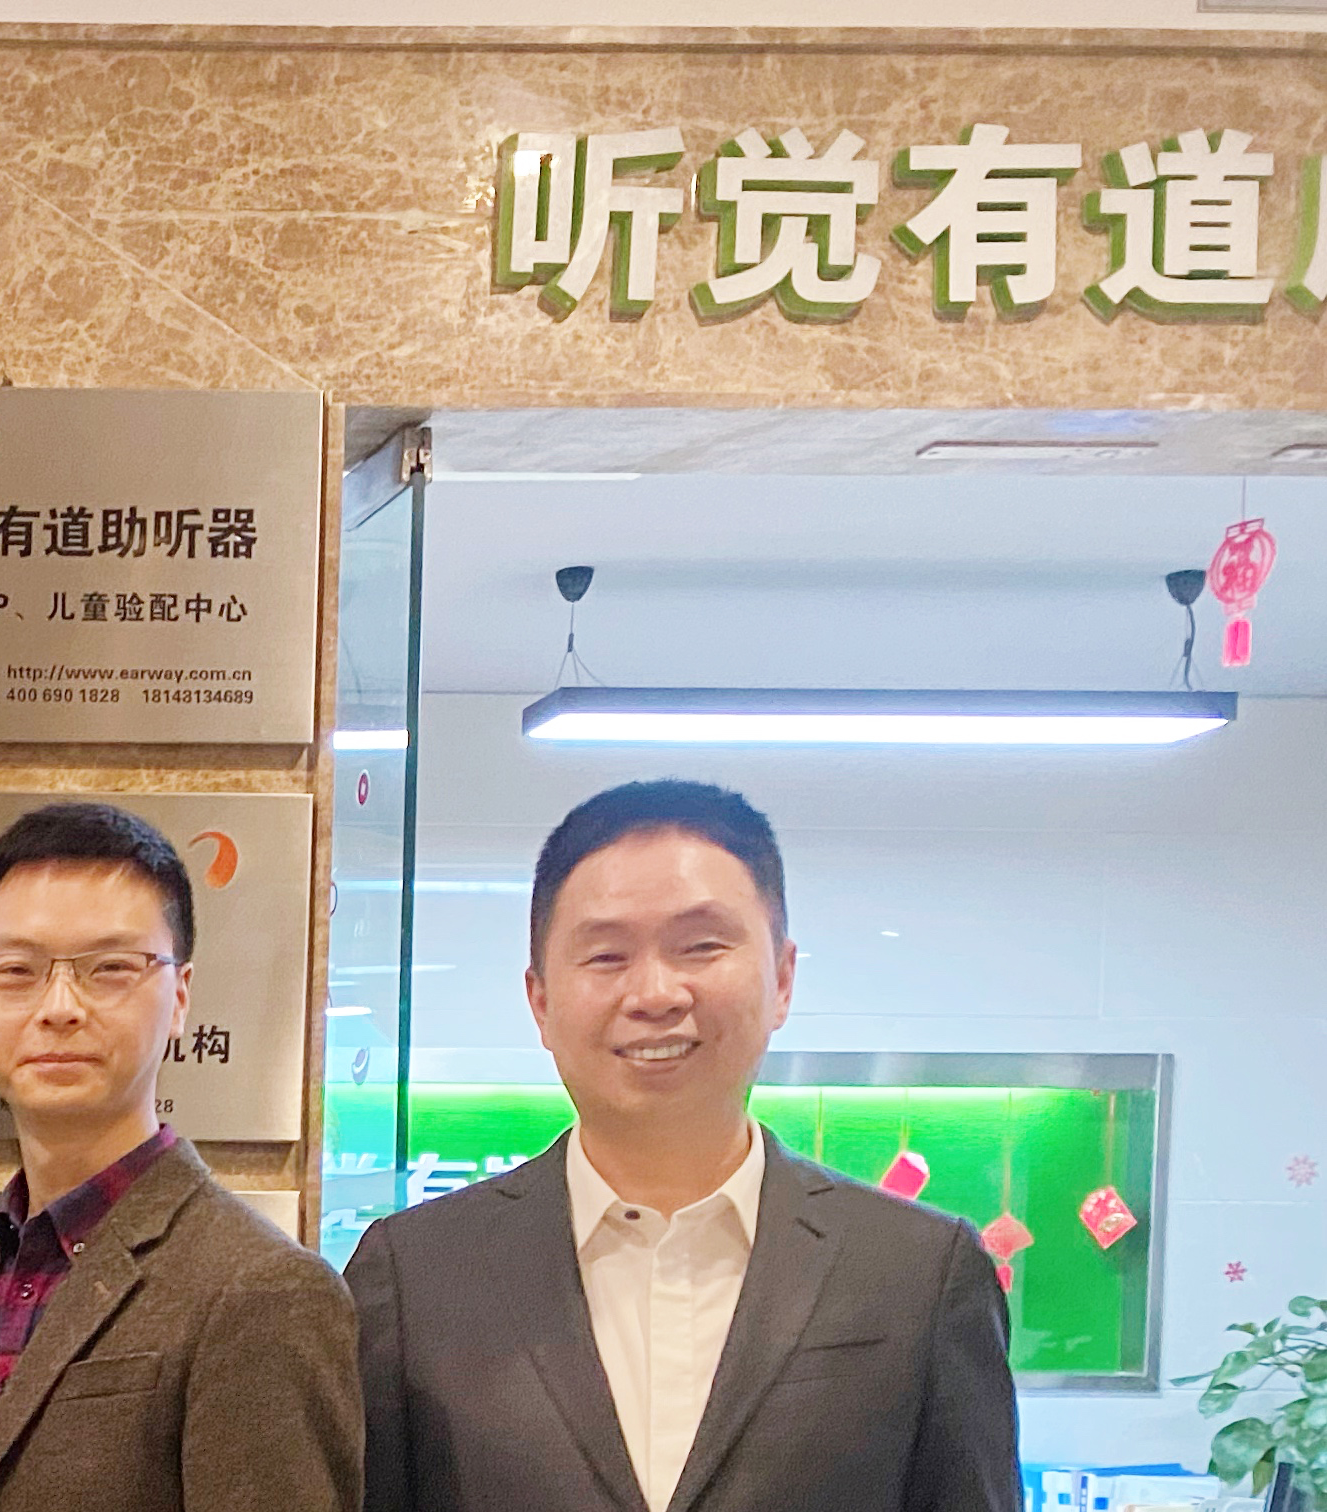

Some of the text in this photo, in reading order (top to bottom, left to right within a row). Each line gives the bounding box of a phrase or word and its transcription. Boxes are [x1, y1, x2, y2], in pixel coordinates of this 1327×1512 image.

[494, 123, 1327, 322] 听觉有道
[6, 687, 37, 702] 400
[43, 687, 73, 702] 690
[79, 688, 120, 703] 1828
